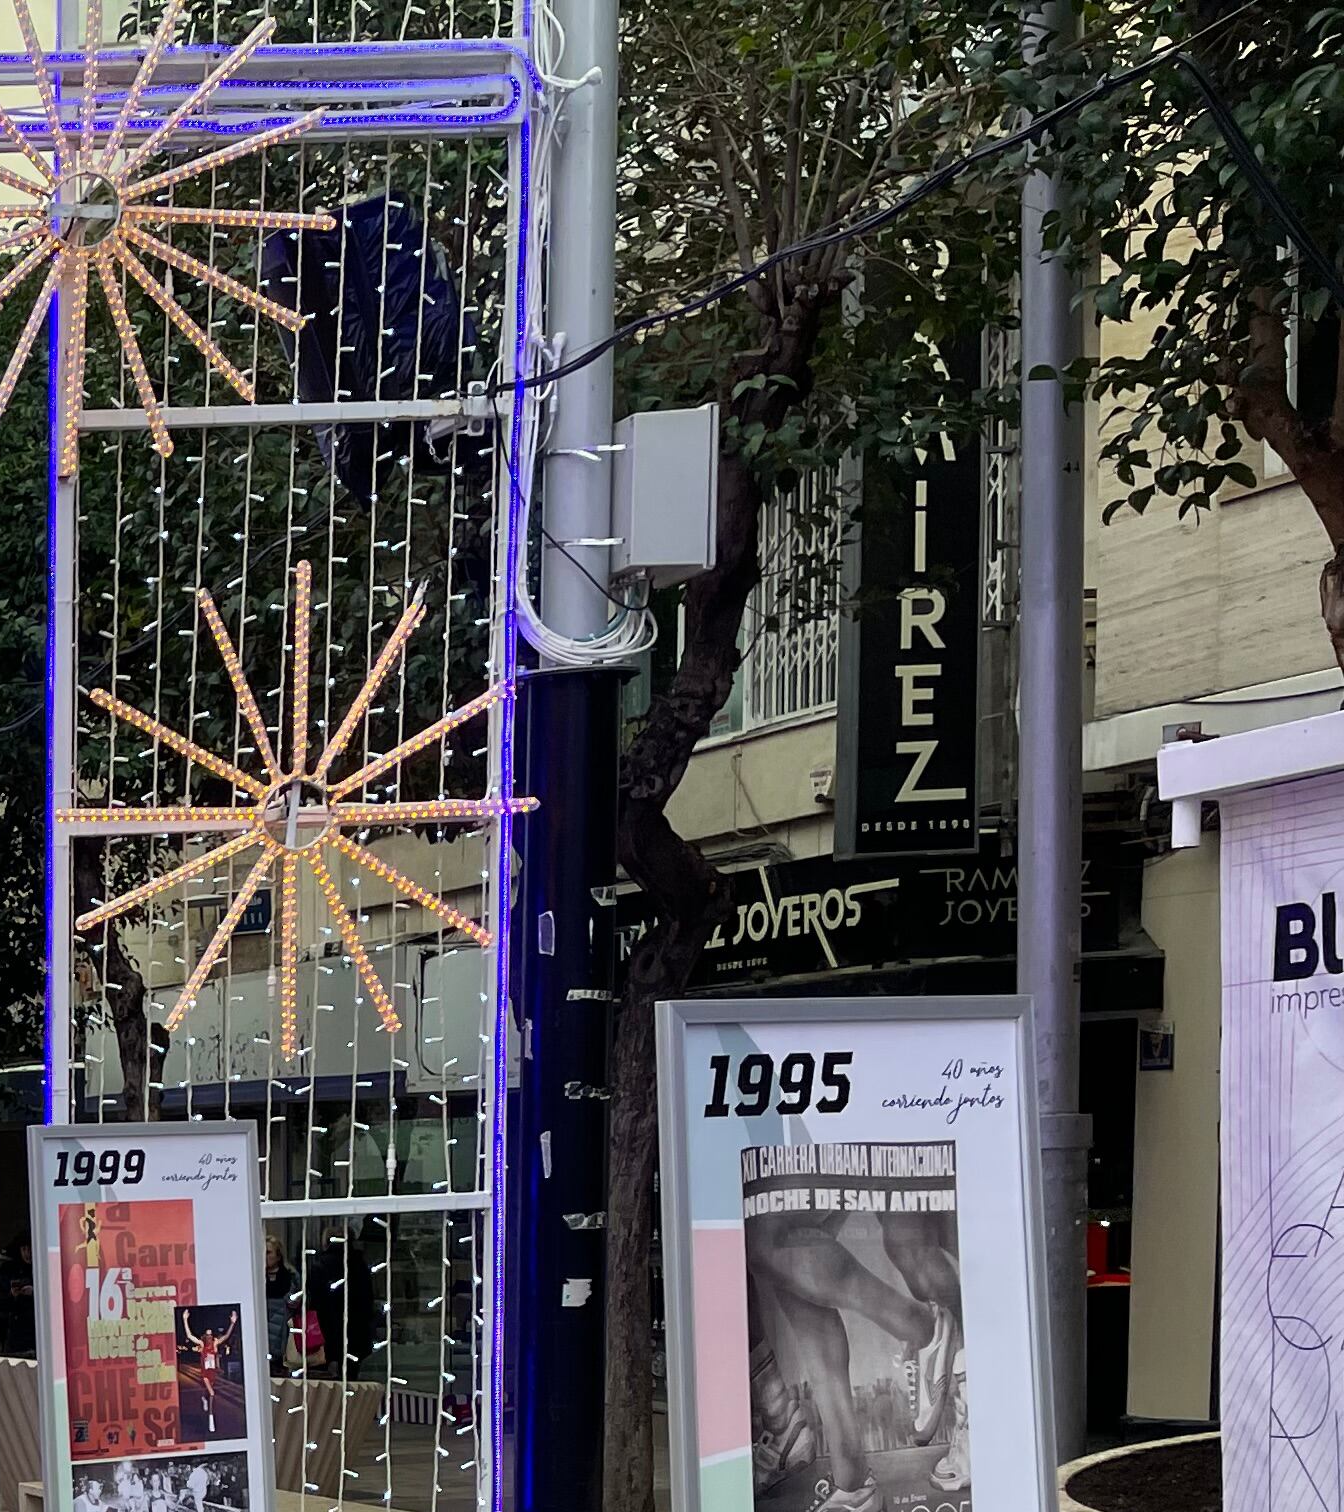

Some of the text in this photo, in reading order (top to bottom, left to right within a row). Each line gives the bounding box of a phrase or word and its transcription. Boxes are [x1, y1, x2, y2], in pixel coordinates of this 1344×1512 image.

[704, 1051, 854, 1118] 1995
[941, 1059, 1004, 1080] 40 años
[881, 1084, 1004, 1125] corriendo juntos
[54, 1149, 146, 1187] 1999
[743, 1142, 956, 1183] XII CARRERA URBANA INTERNACIONAL
[744, 1188, 956, 1218] NOCHE DE SAN ANTON
